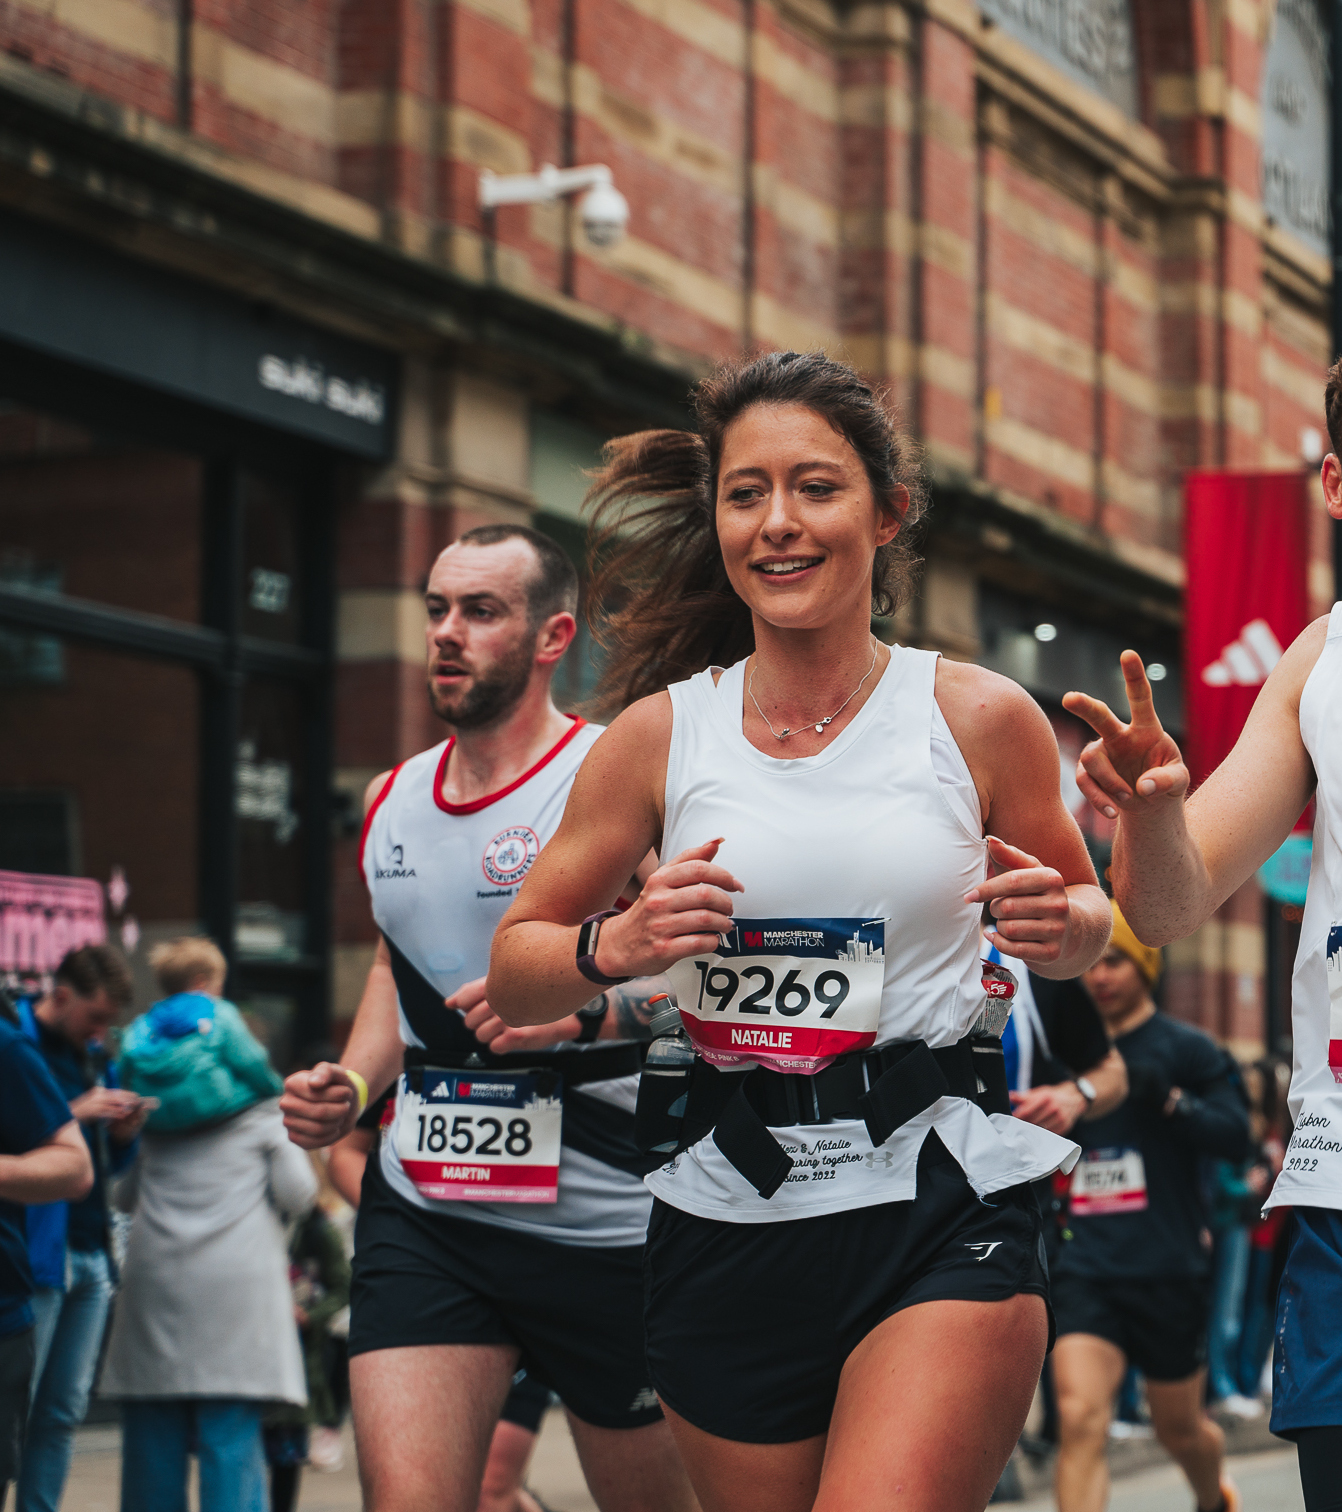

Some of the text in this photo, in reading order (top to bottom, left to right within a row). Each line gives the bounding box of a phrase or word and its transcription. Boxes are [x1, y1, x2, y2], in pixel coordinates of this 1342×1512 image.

[763, 930, 824, 940] MANCHESTER
[763, 937, 825, 947] MARATHON
[694, 961, 850, 1019] 19269
[731, 1028, 793, 1049] NATALIE
[418, 1114, 532, 1157] 18528
[781, 1139, 852, 1155] lex & Natalie
[822, 1153, 863, 1167] together
[1286, 1158, 1318, 1172] 2022
[441, 1165, 491, 1181] MARTIN
[784, 1170, 836, 1183] since 2022
